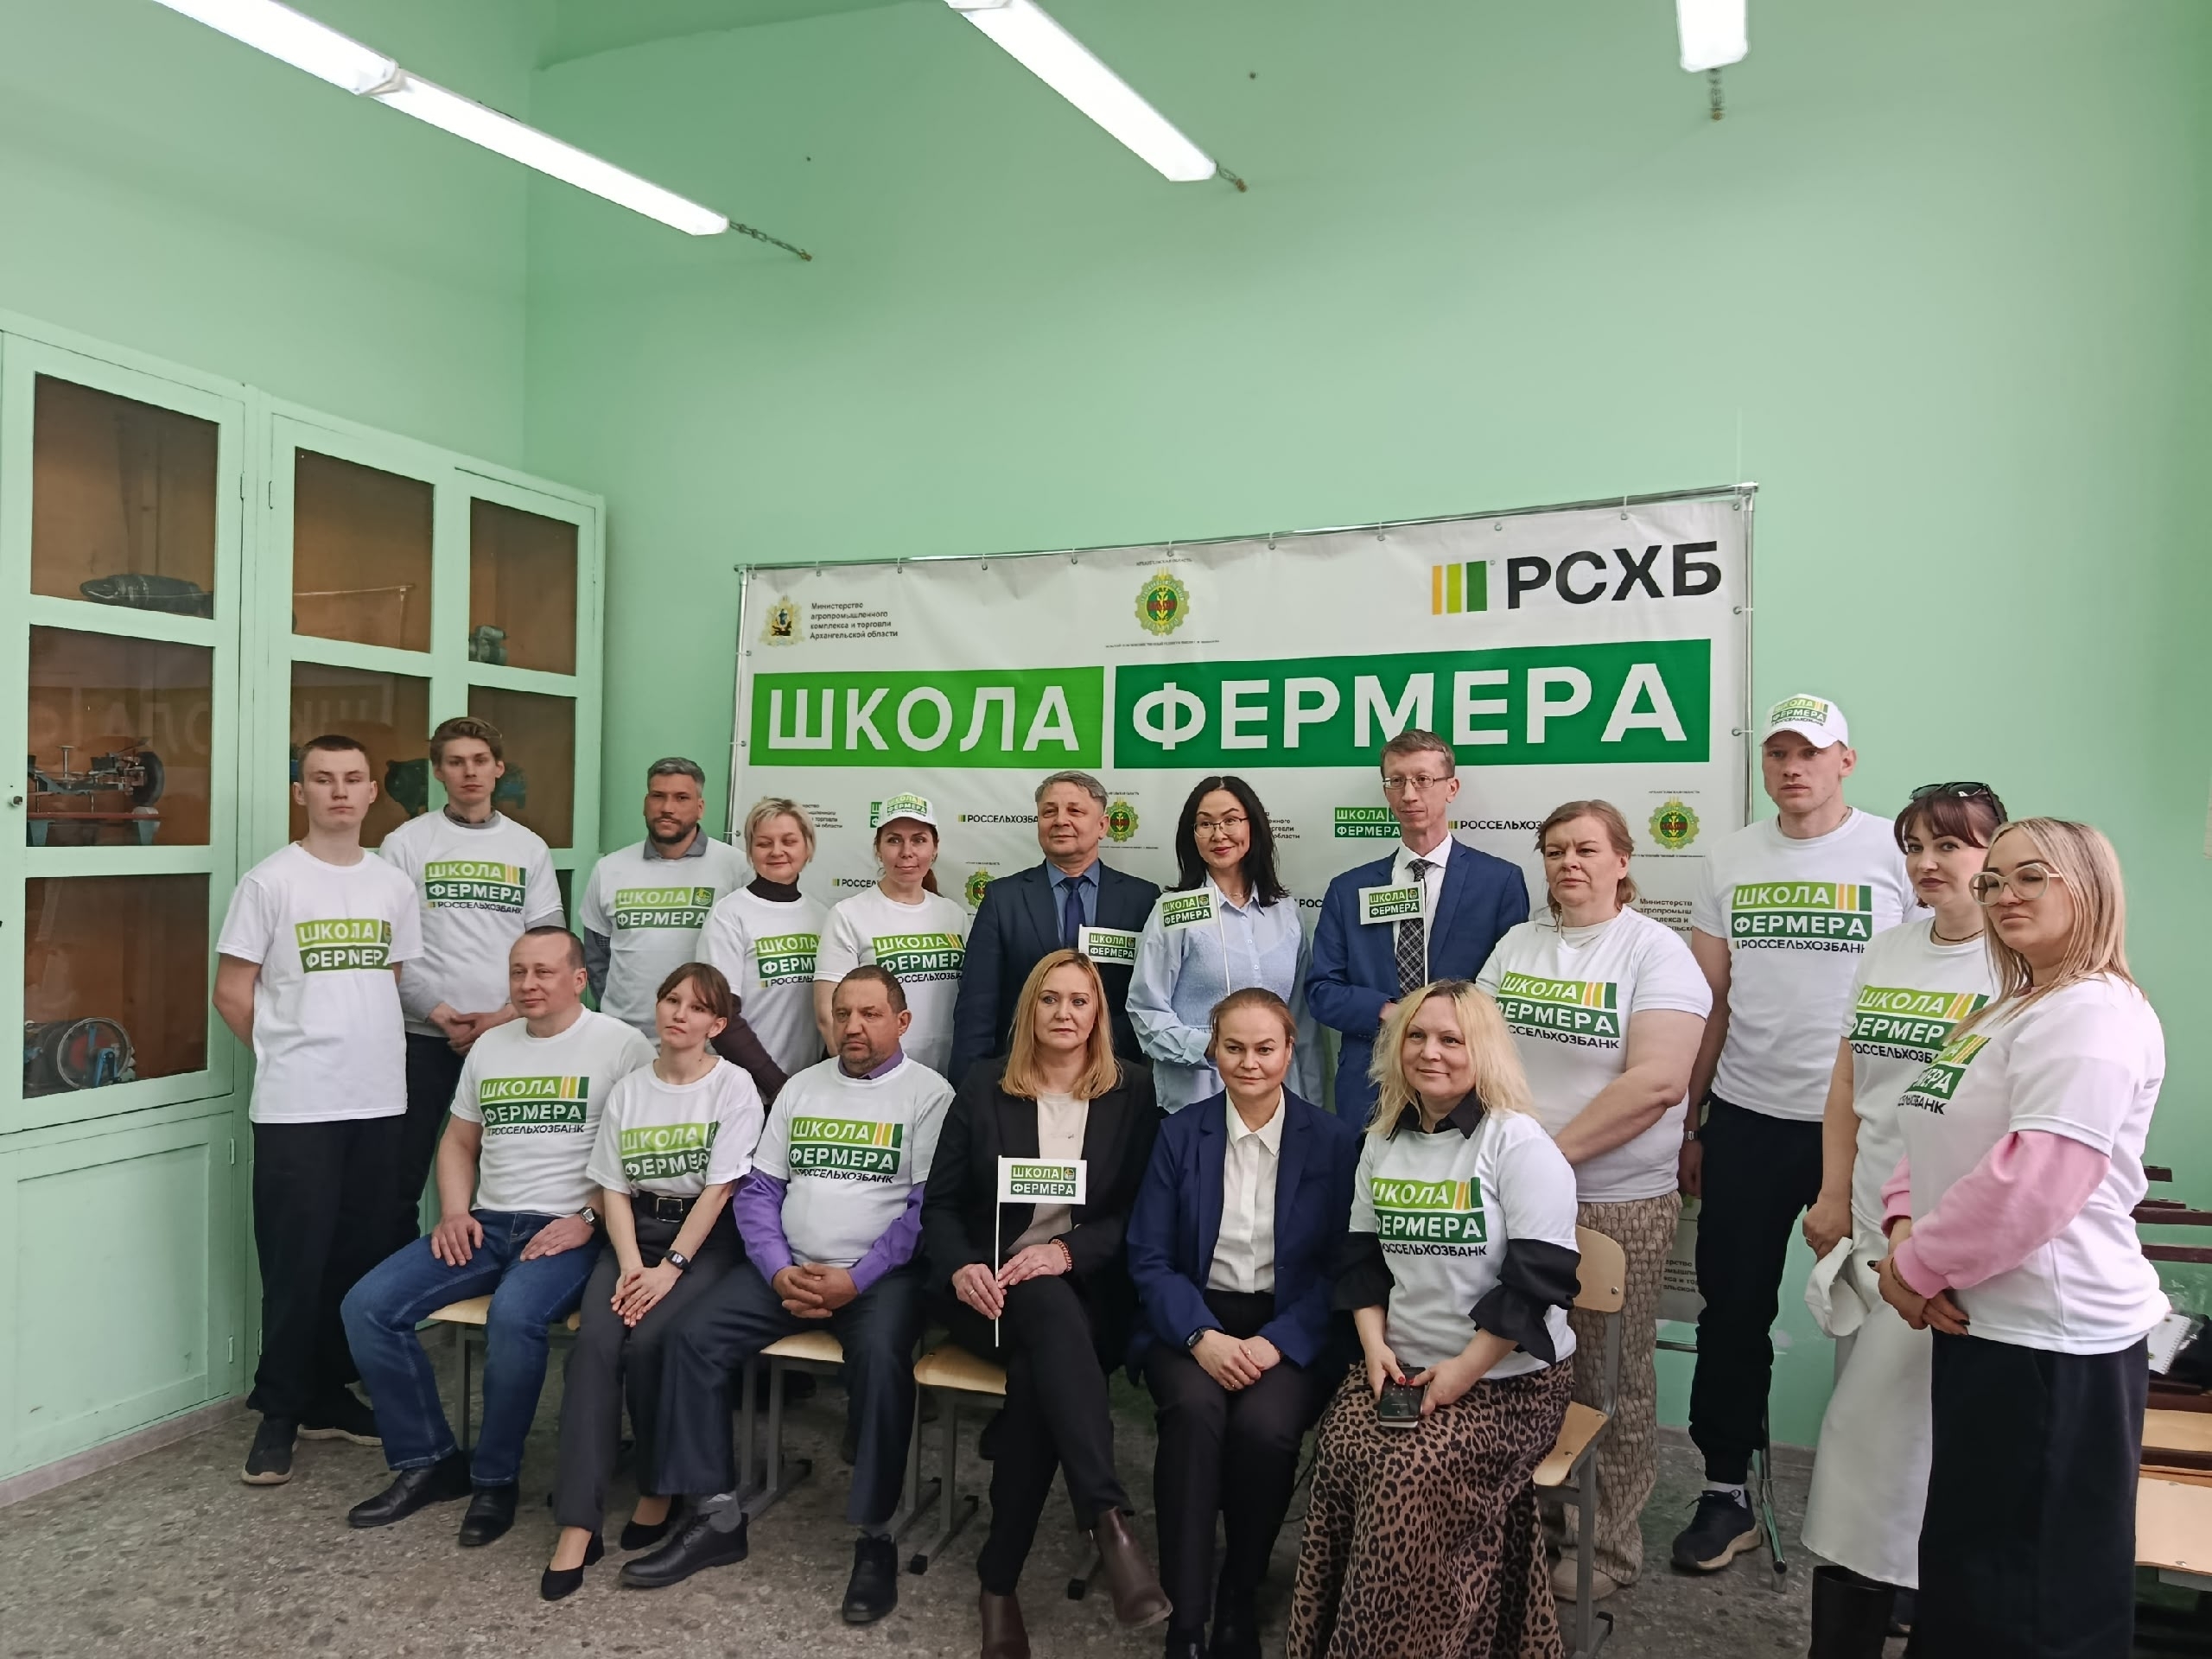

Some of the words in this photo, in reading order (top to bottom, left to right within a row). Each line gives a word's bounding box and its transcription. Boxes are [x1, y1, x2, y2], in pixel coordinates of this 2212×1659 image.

[1507, 541, 1722, 610] РСХБ
[811, 602, 864, 611] Министерство
[810, 611, 888, 620] агропромышленного
[857, 620, 892, 630] торговли
[810, 630, 866, 641] Архангельской
[867, 629, 899, 638] области
[768, 685, 1080, 753] ШКОЛА
[1133, 663, 1688, 750] ФЕРМЕРА
[1772, 709, 1825, 722] ФЕРМЕРА
[887, 802, 926, 813] ФЕРМЕРА
[967, 814, 1039, 823] РОССЕЛЬХОЗБА
[1336, 809, 1385, 821] ШКОЛА
[1336, 823, 1401, 837] ФЕРМЕРА
[429, 864, 503, 880] ШКОЛА
[429, 883, 522, 903] ФЕРМЕРА
[618, 890, 687, 905] ШКОЛА
[1370, 891, 1406, 904] ШКОЛА
[1737, 886, 1830, 906] ШКОЛА
[437, 901, 523, 915] РОССЕЛЬХОЗБАНК
[1163, 898, 1196, 912] ШКОЛА
[1370, 903, 1418, 916] ФЕРМЕРА
[1640, 899, 1693, 907] Министерств
[1164, 909, 1211, 925] ФЕРМЕРА
[298, 922, 375, 943] ШКОЛА
[1733, 915, 1867, 938] ФЕРМЕРА
[759, 937, 817, 953] ШКОЛА
[876, 935, 949, 951] ШКОЛА
[1090, 934, 1124, 945] ШКОЛА
[1090, 947, 1134, 958] ФЕРМЕРА
[1501, 976, 1577, 1000] ШКОЛА
[1858, 989, 1944, 1014] ШКОЛА
[481, 1079, 556, 1098] ШКОЛА
[484, 1103, 582, 1123] ФЕРМЕРА
[793, 1120, 869, 1141] ШКОЛА
[622, 1126, 697, 1152] ШКОЛА
[790, 1147, 894, 1171] ФЕРМЕРА
[1013, 1166, 1059, 1179] ШКОЛА
[1012, 1183, 1074, 1195] ФЕРМЕРА
[1382, 1243, 1487, 1256] ОССЕЛЬХОЗБАНК
